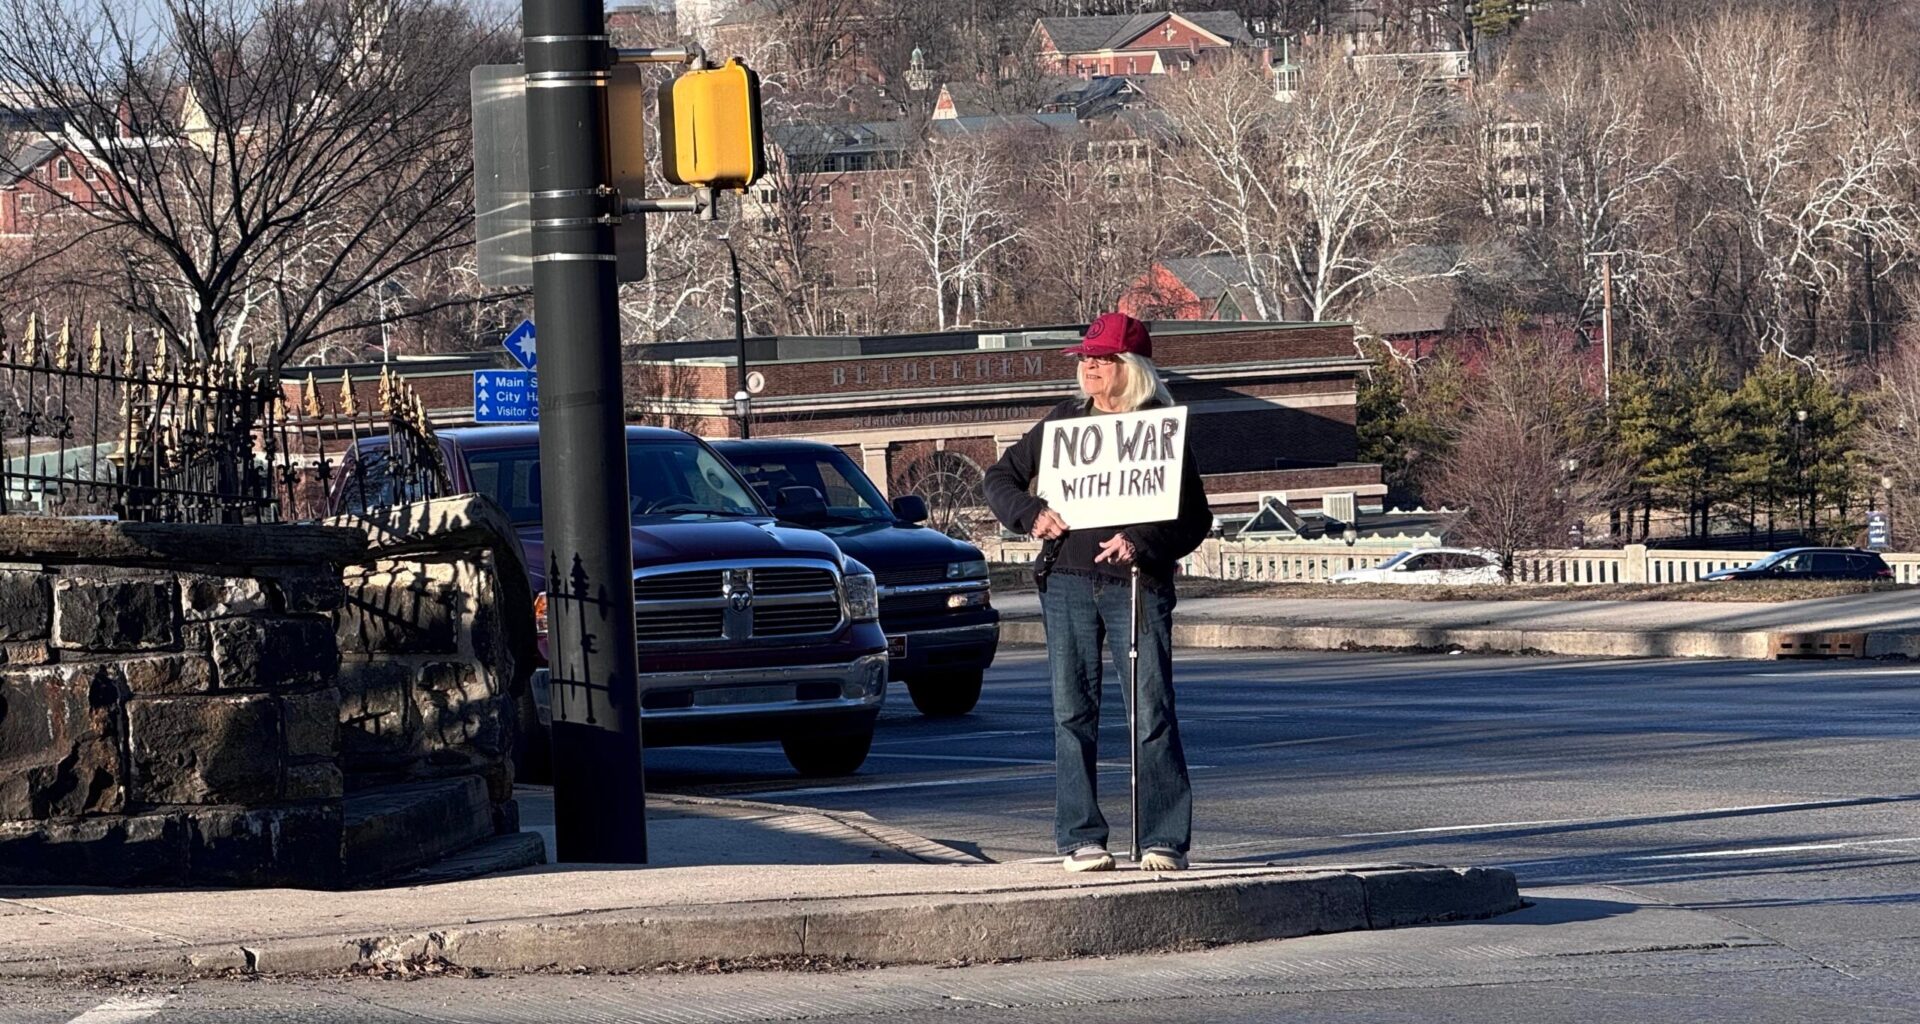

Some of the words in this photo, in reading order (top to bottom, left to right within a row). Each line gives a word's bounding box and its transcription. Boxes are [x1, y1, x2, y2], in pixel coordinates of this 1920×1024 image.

[831, 356, 1043, 386] BETHLEHEM
[495, 376, 524, 387] Main
[530, 377, 538, 388] S
[496, 391, 520, 403] City
[496, 405, 527, 417] Visitor
[531, 406, 539, 417] C
[1052, 423, 1103, 469] NO
[1115, 417, 1179, 463] WAR
[1061, 471, 1112, 502] WITH
[1119, 465, 1166, 497] IRAN
